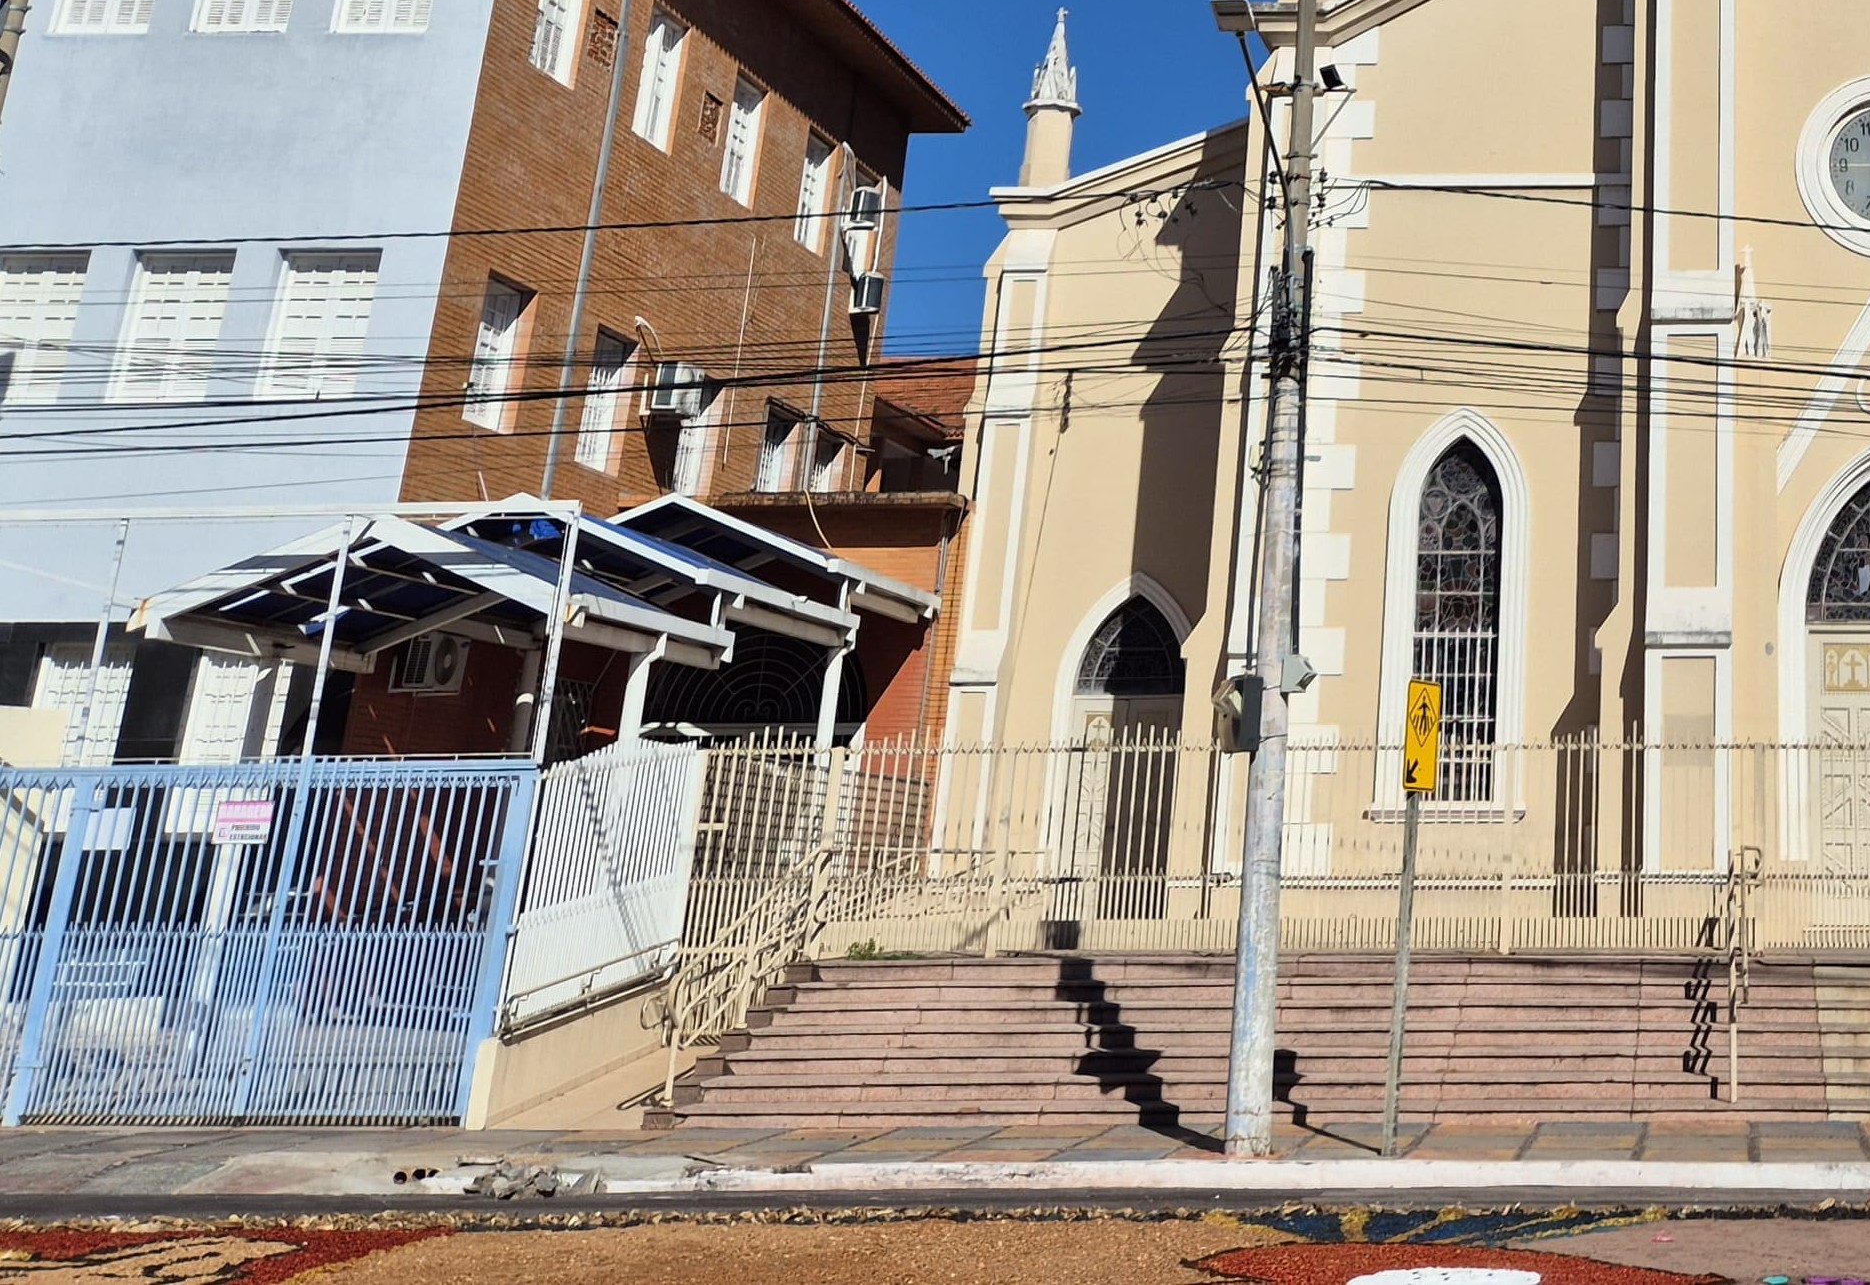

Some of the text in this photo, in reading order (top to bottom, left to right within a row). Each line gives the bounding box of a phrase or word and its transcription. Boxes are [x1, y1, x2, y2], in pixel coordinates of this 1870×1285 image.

[1860, 122, 1870, 136] 11
[1844, 137, 1859, 152] 10
[1838, 158, 1848, 173] 9
[1845, 179, 1855, 195] 8
